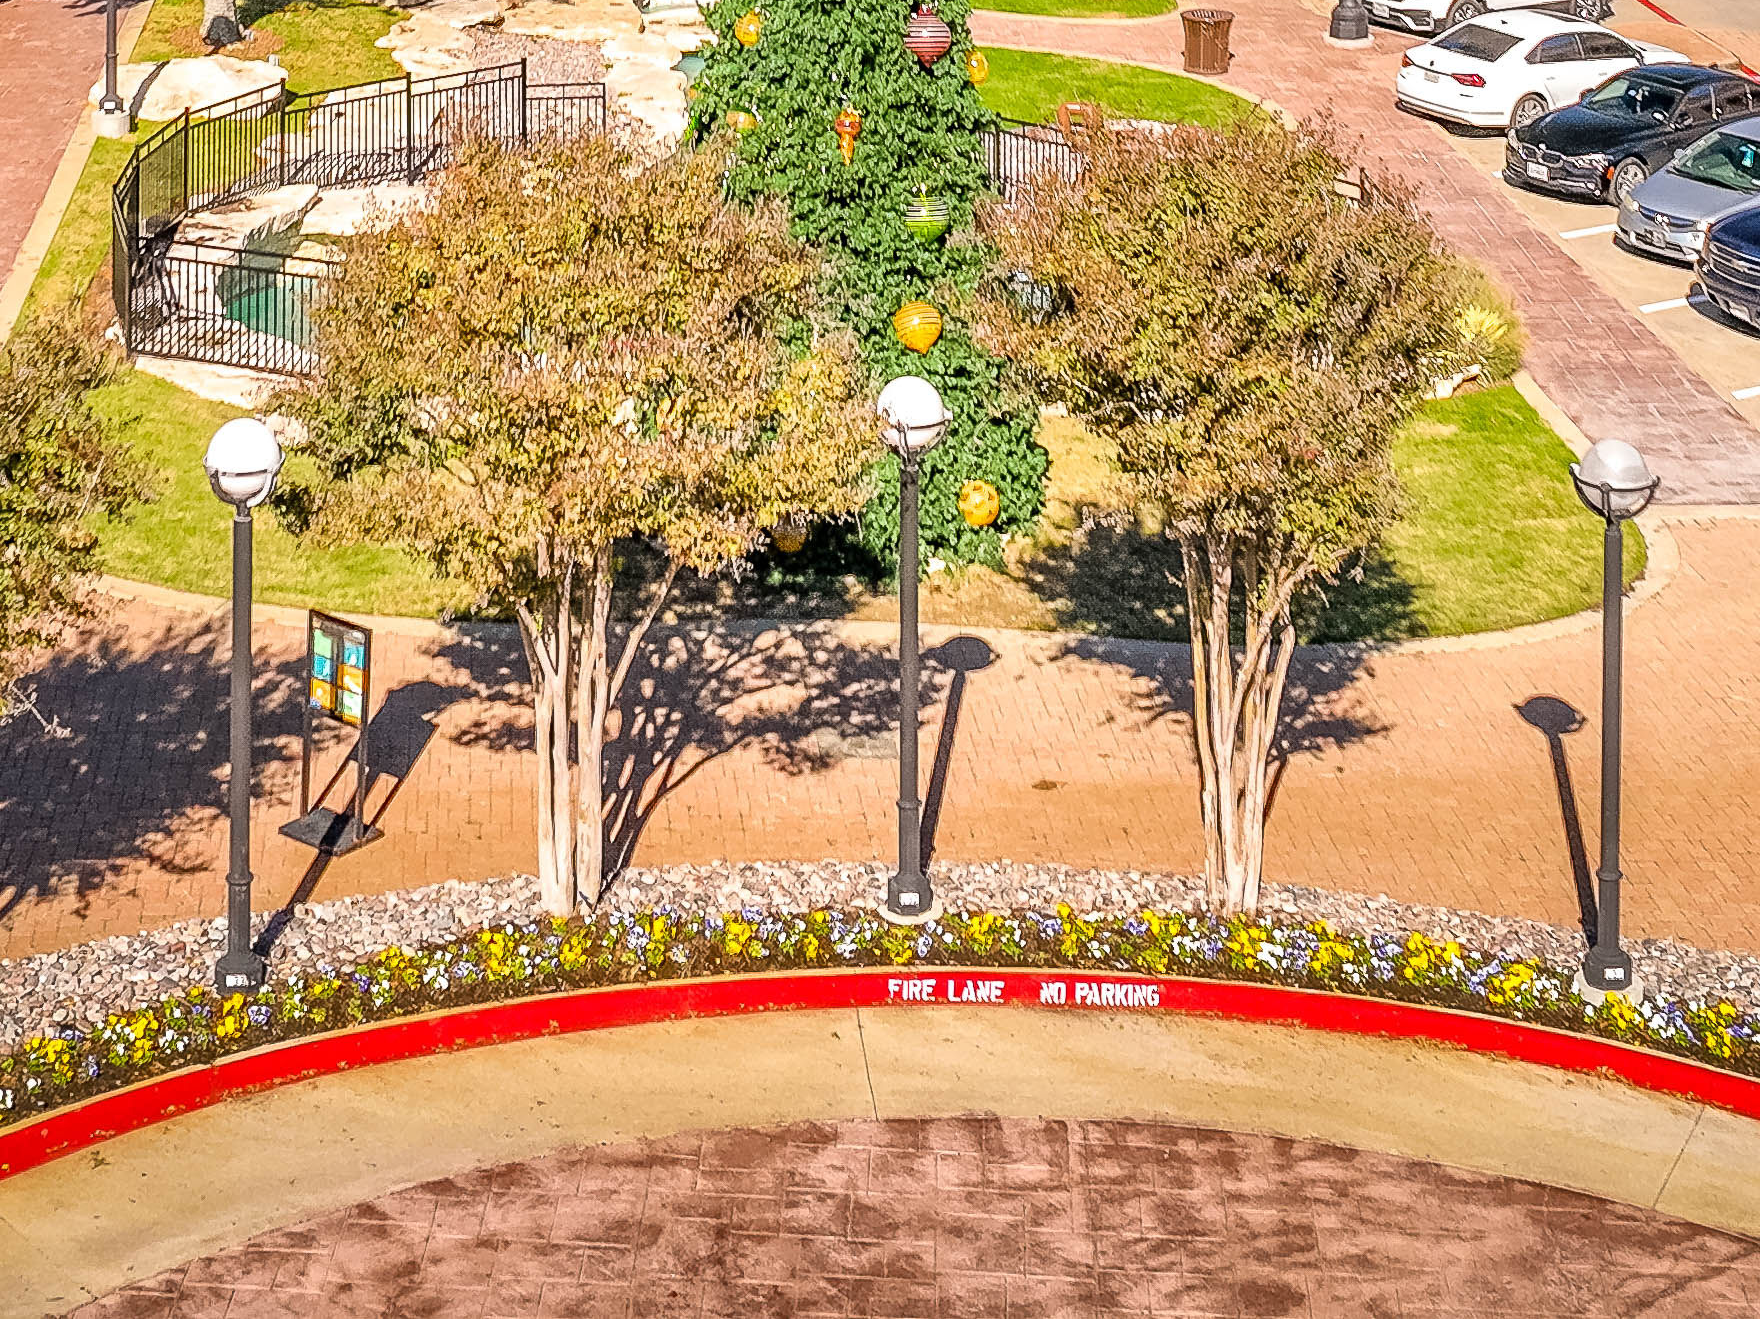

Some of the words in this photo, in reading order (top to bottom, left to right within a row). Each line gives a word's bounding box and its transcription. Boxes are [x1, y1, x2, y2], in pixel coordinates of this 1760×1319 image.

[888, 978, 937, 1003] FIRE
[947, 979, 1006, 1004] LANE
[1039, 981, 1067, 1005] NO
[1074, 982, 1160, 1007] PARKING
